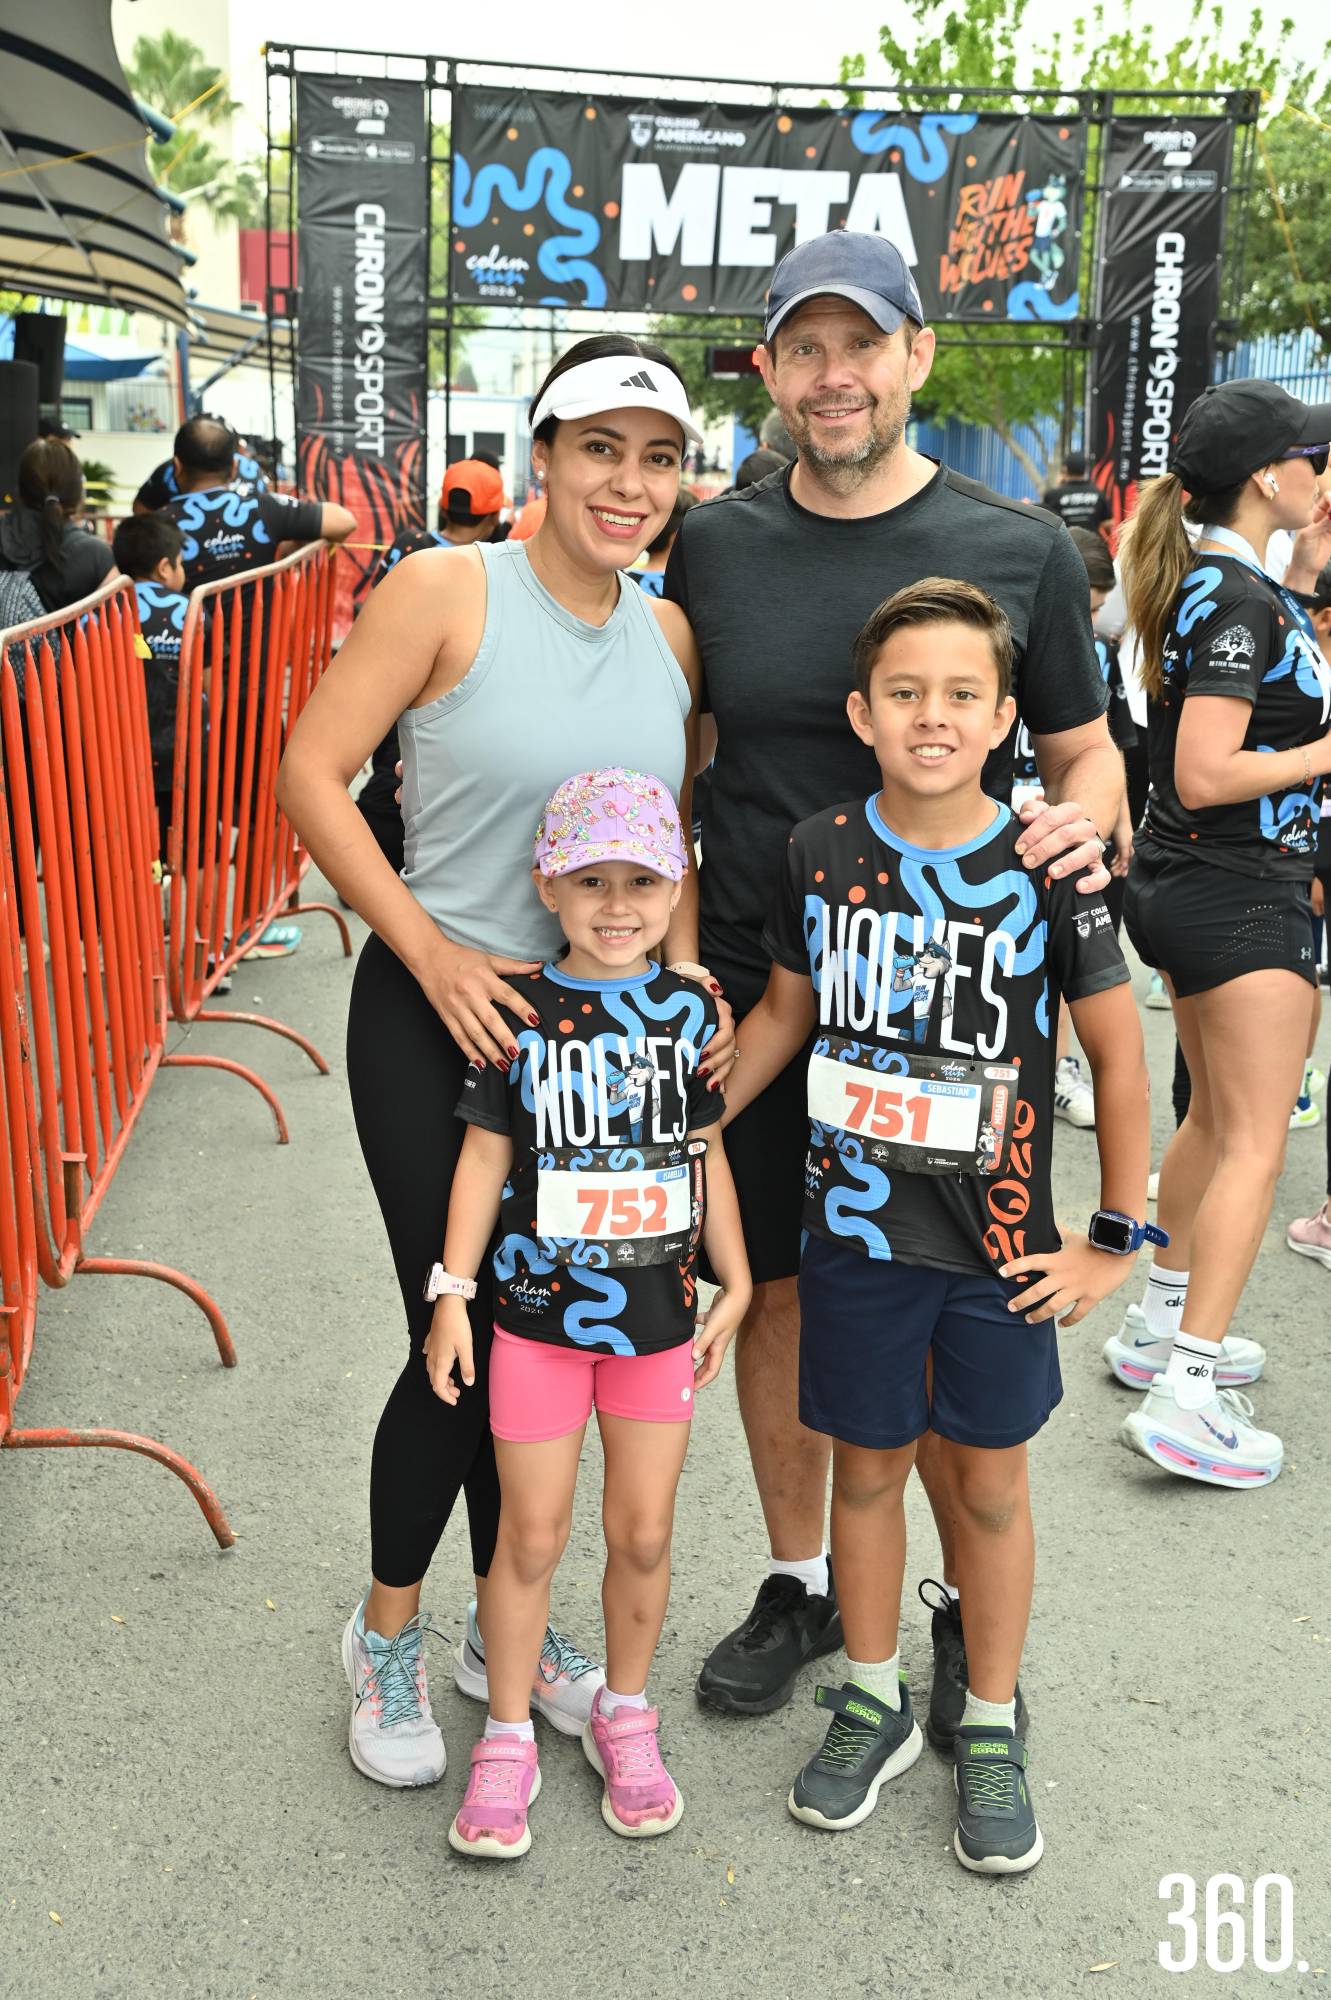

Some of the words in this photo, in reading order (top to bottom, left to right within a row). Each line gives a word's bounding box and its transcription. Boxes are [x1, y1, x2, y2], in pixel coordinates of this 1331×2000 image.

[654, 128, 746, 147] AMERICANO
[955, 170, 1026, 227] RUN
[619, 163, 918, 267] META
[465, 244, 530, 271] colam
[203, 529, 245, 548] colam
[820, 904, 1016, 1060] WOLVES
[940, 1061, 967, 1072] colam
[993, 1068, 1010, 1079] 751
[530, 1036, 695, 1149] WOLVES
[927, 1083, 969, 1096] SEBASTIAN
[845, 1081, 931, 1143] 751
[577, 1185, 668, 1236] 752
[509, 1278, 551, 1297] colam
[513, 1292, 549, 1307] run
[1186, 1364, 1209, 1378] alo
